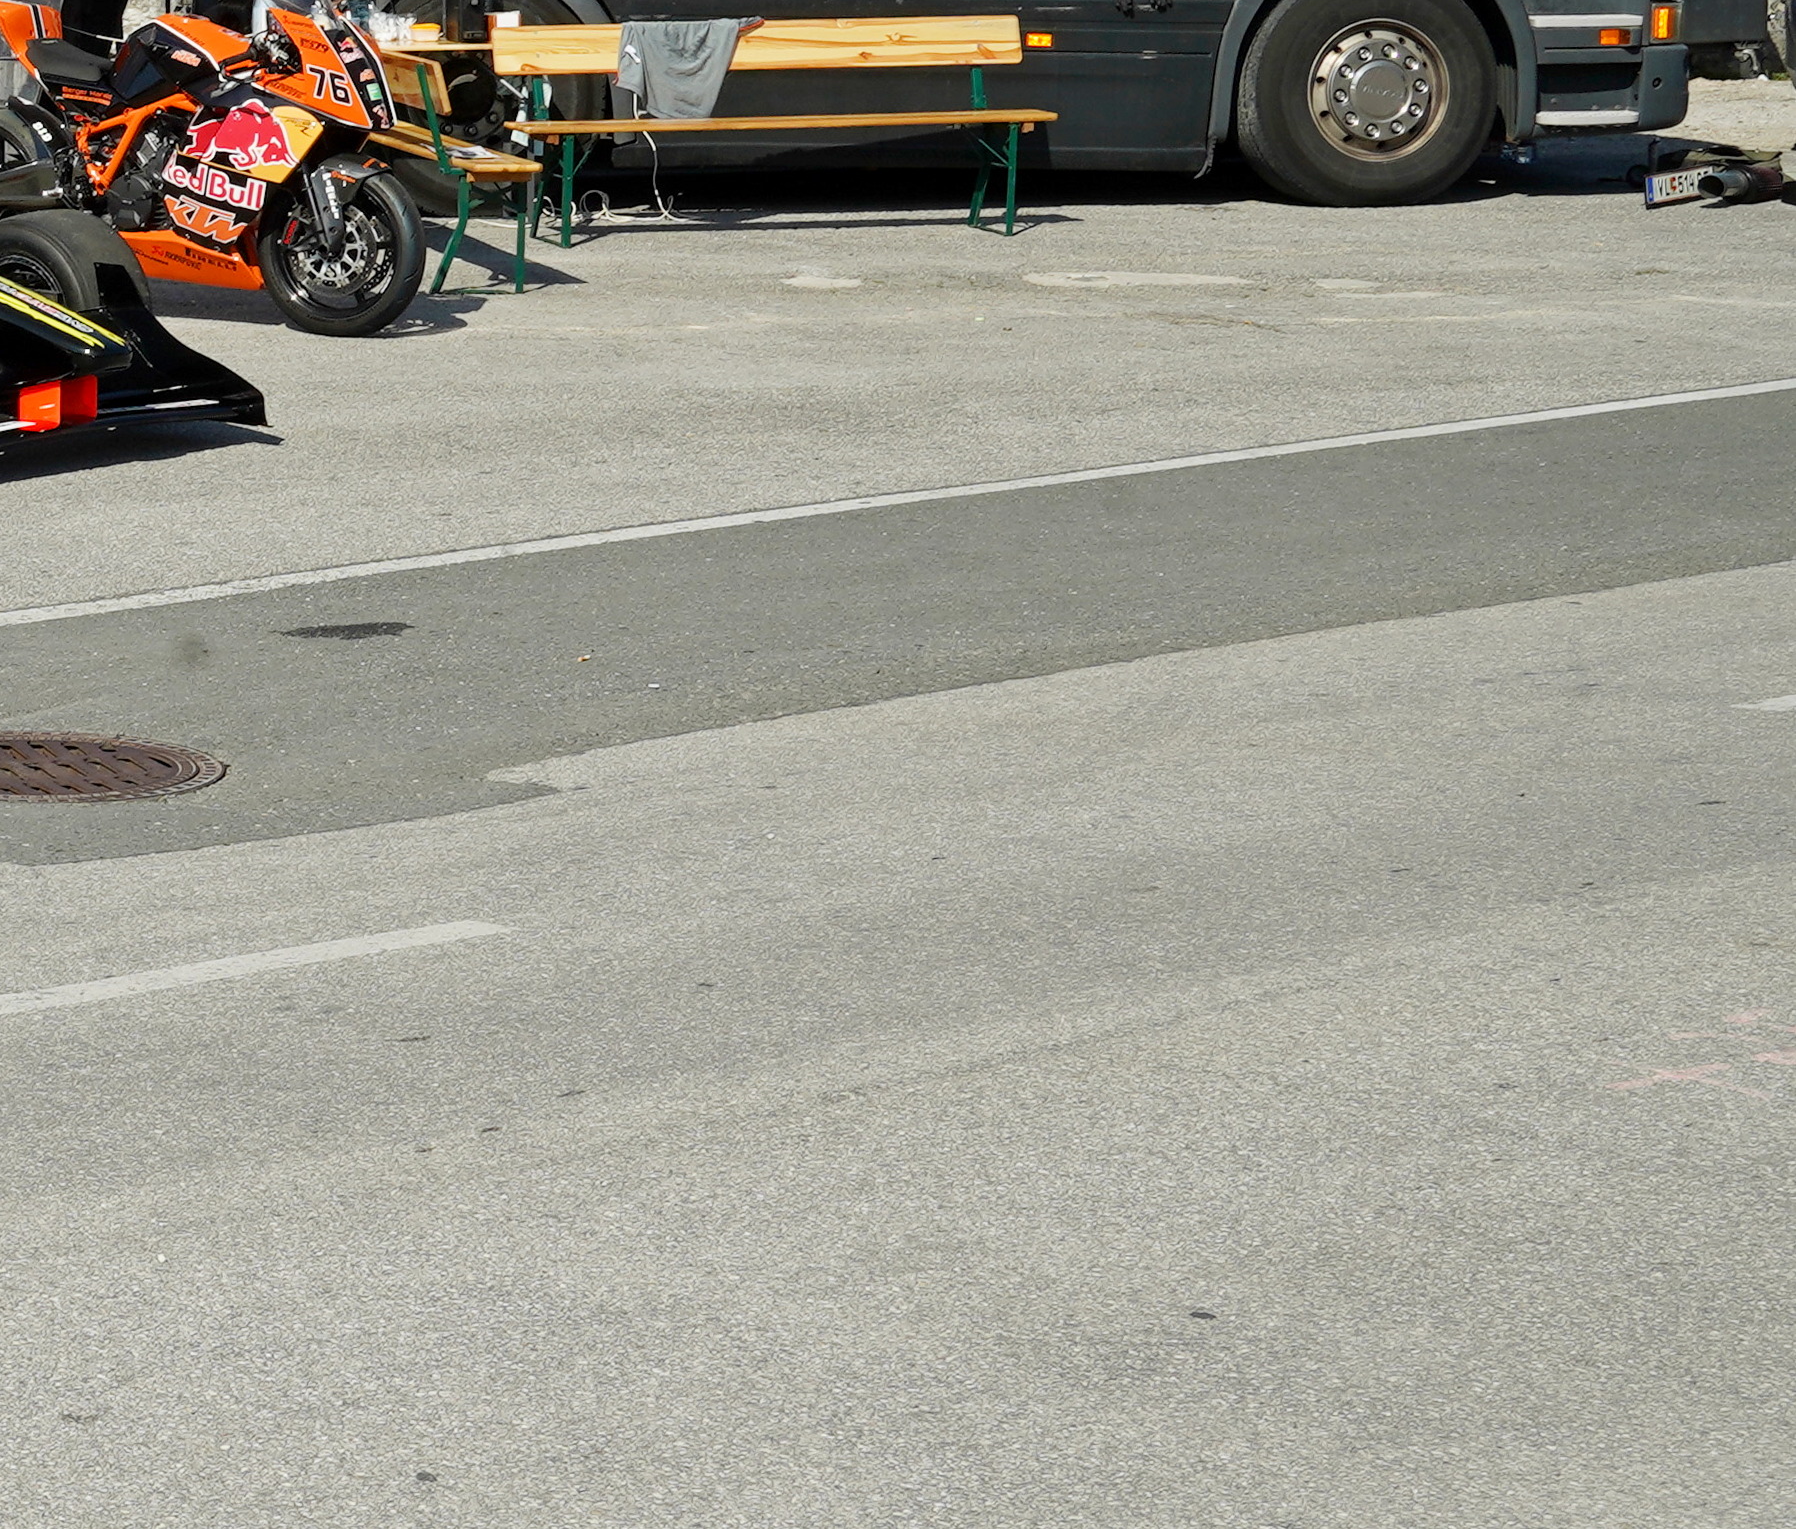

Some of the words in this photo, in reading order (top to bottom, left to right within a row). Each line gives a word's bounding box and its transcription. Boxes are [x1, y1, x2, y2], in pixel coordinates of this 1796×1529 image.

[306, 64, 353, 107] 76
[207, 169, 267, 211] Bull
[164, 194, 249, 244] KTM
